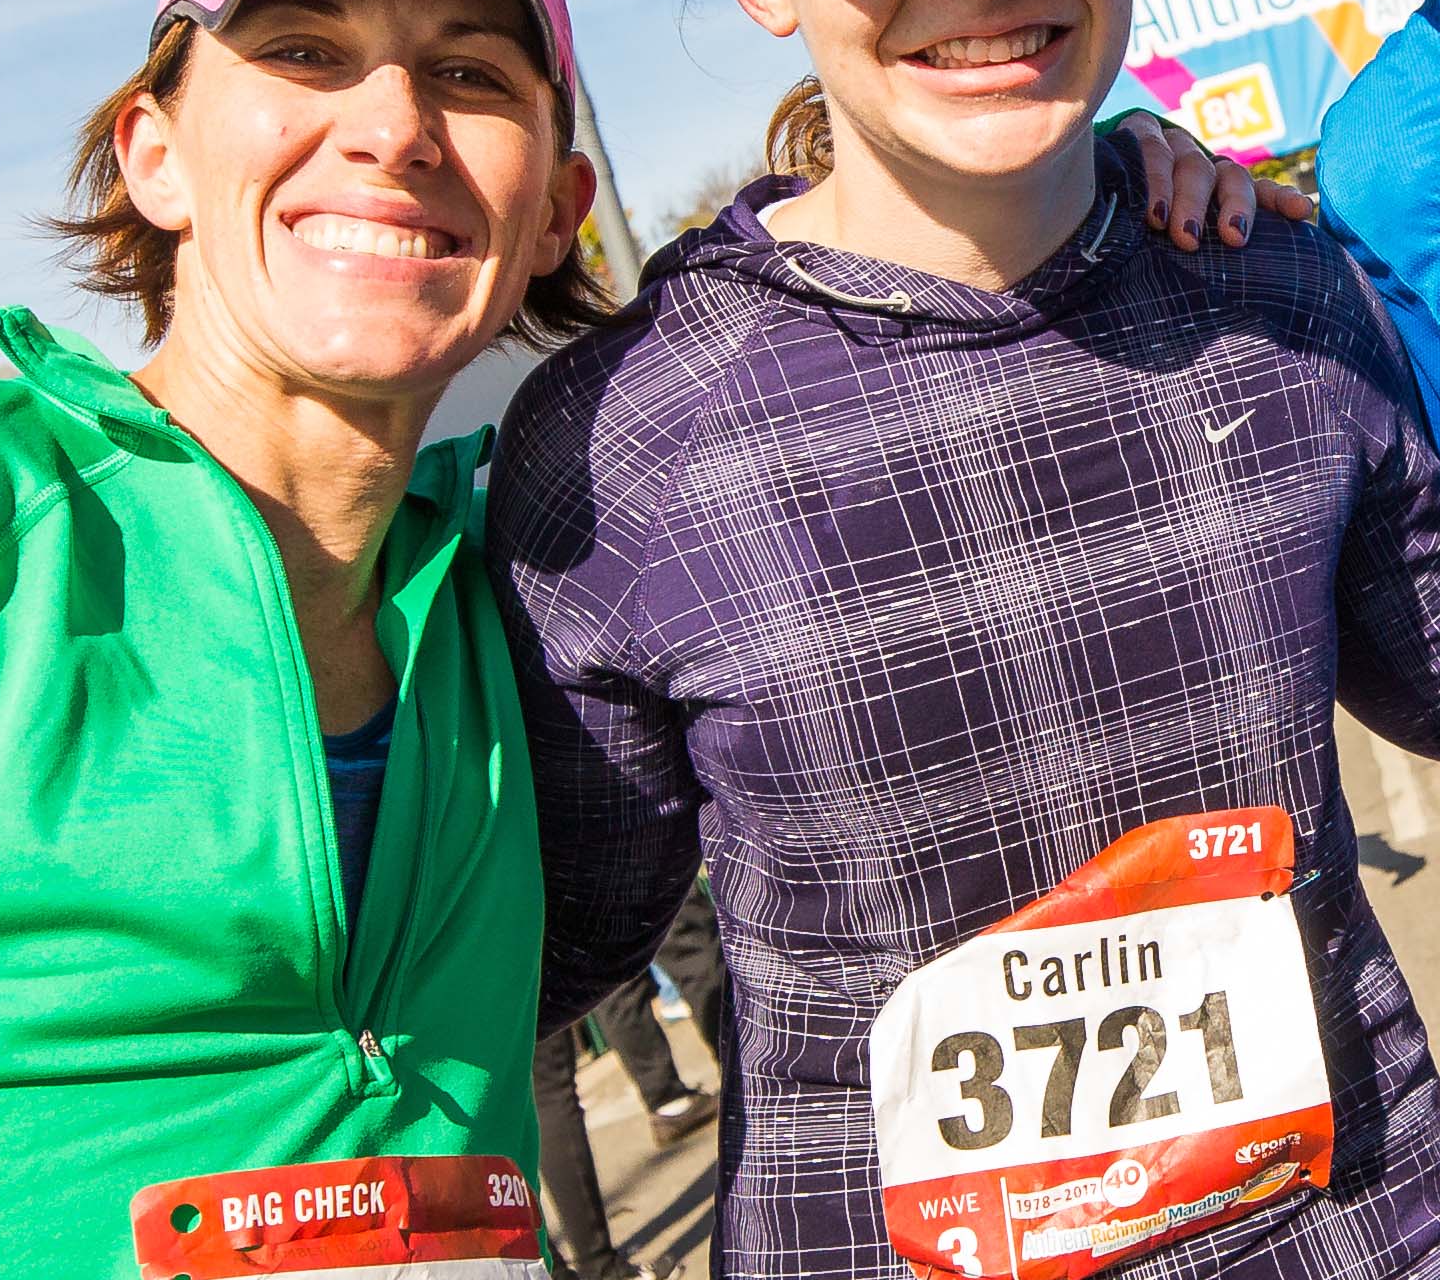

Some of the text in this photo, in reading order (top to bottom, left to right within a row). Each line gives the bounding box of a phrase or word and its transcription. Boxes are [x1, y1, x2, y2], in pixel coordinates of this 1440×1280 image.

[1201, 81, 1263, 138] 8K
[1187, 822, 1263, 860] 3721
[1003, 934, 1163, 1002] Carlin
[931, 990, 1244, 1151] 3721
[488, 1174, 532, 1208] 3201
[918, 1191, 980, 1218] WAVE
[1106, 1167, 1141, 1190] 40
[222, 1181, 386, 1232] BAG CHECK
[1023, 1228, 1092, 1257] Anthem
[1091, 1210, 1166, 1245] Richmond
[1168, 1187, 1240, 1219] Marathon
[936, 1225, 984, 1279] 3
